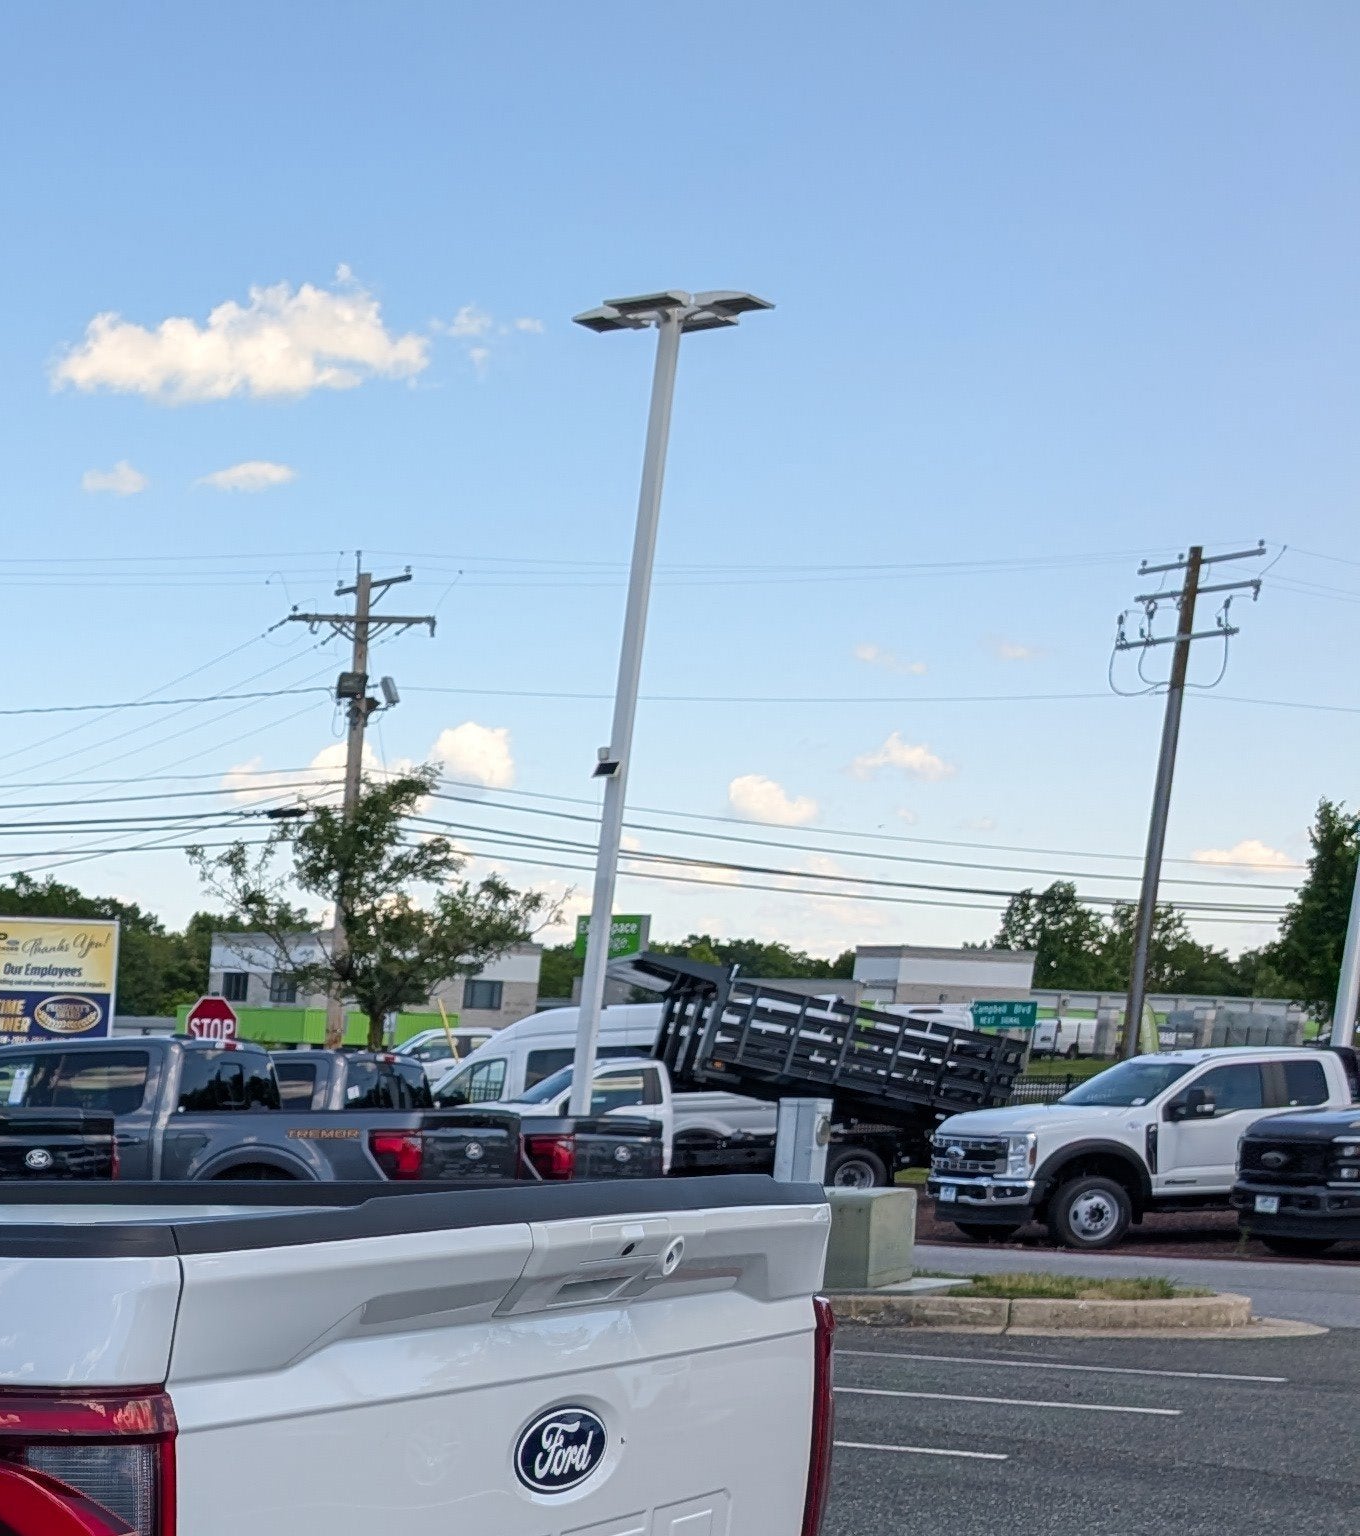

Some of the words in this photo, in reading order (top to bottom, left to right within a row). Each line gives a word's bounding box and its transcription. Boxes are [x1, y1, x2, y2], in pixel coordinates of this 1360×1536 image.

[21, 937, 70, 957] Thanks
[73, 932, 112, 959] You!
[3, 962, 23, 976] Our
[25, 963, 83, 979] Employees
[1013, 1003, 1032, 1015] Blvd
[190, 1017, 234, 1039] STOP
[288, 1129, 359, 1139] TREMOR
[534, 1420, 594, 1479] Ford
